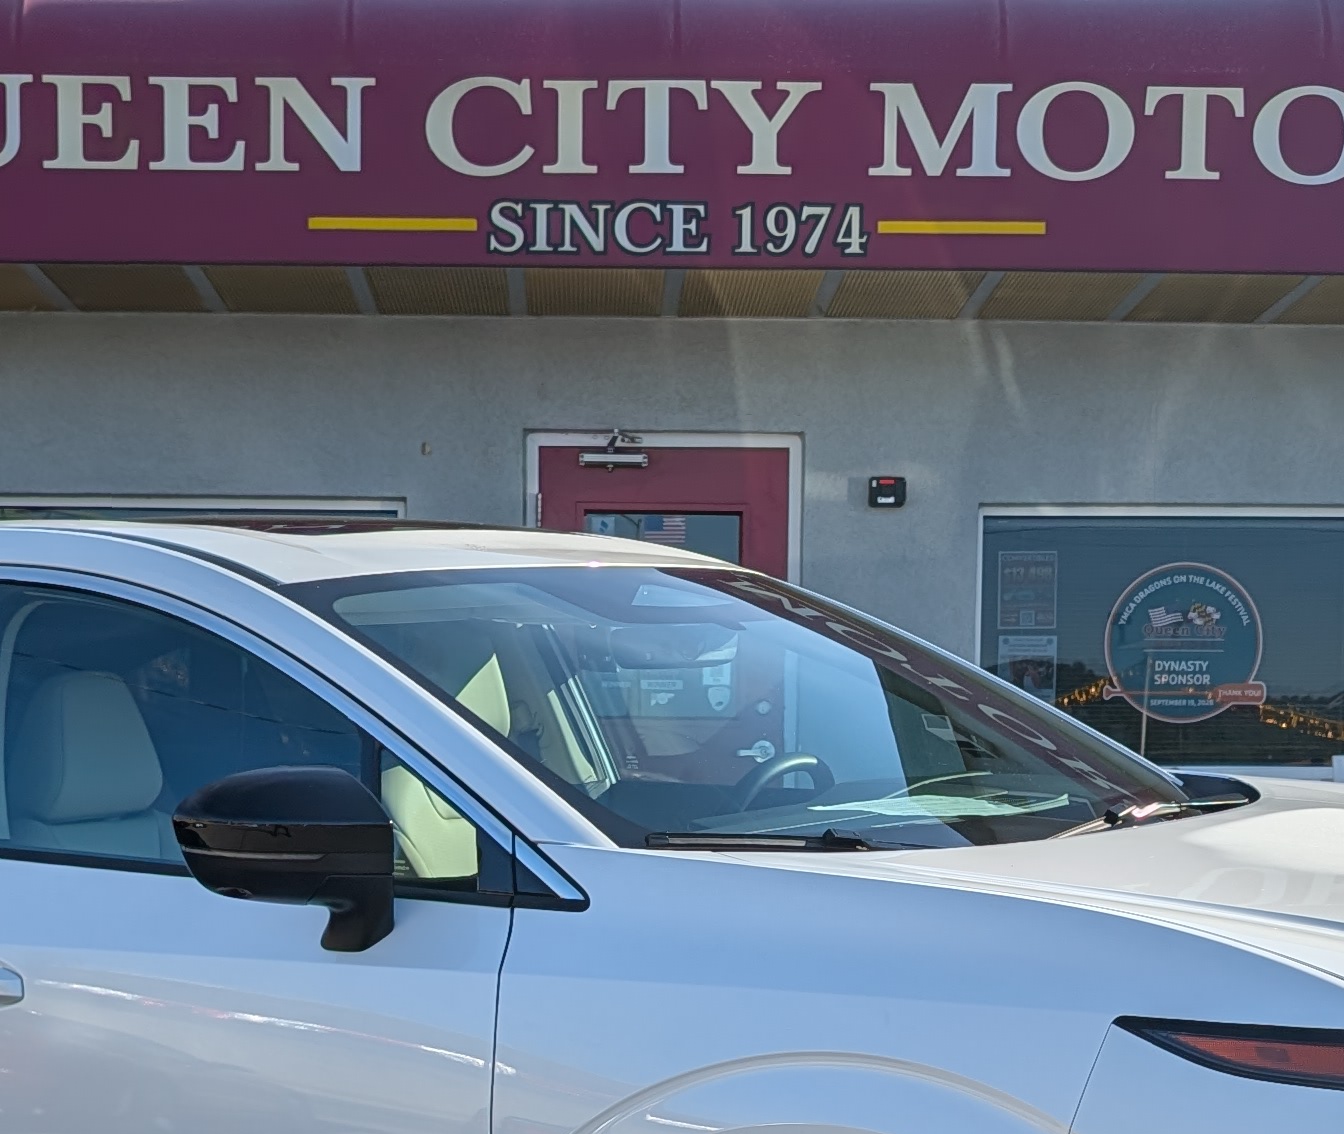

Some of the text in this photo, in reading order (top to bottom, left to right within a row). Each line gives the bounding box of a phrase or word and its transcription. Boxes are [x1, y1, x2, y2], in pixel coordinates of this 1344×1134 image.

[425, 76, 823, 178] CITY
[488, 200, 868, 255] SINCE 1974
[1118, 574, 1251, 626] YMCA DRAGONS ON THE LAKE FESTIVAL
[1142, 623, 1227, 638] Queen City
[1154, 660, 1208, 672] DYNASTY
[1154, 674, 1211, 685] SPONSOR
